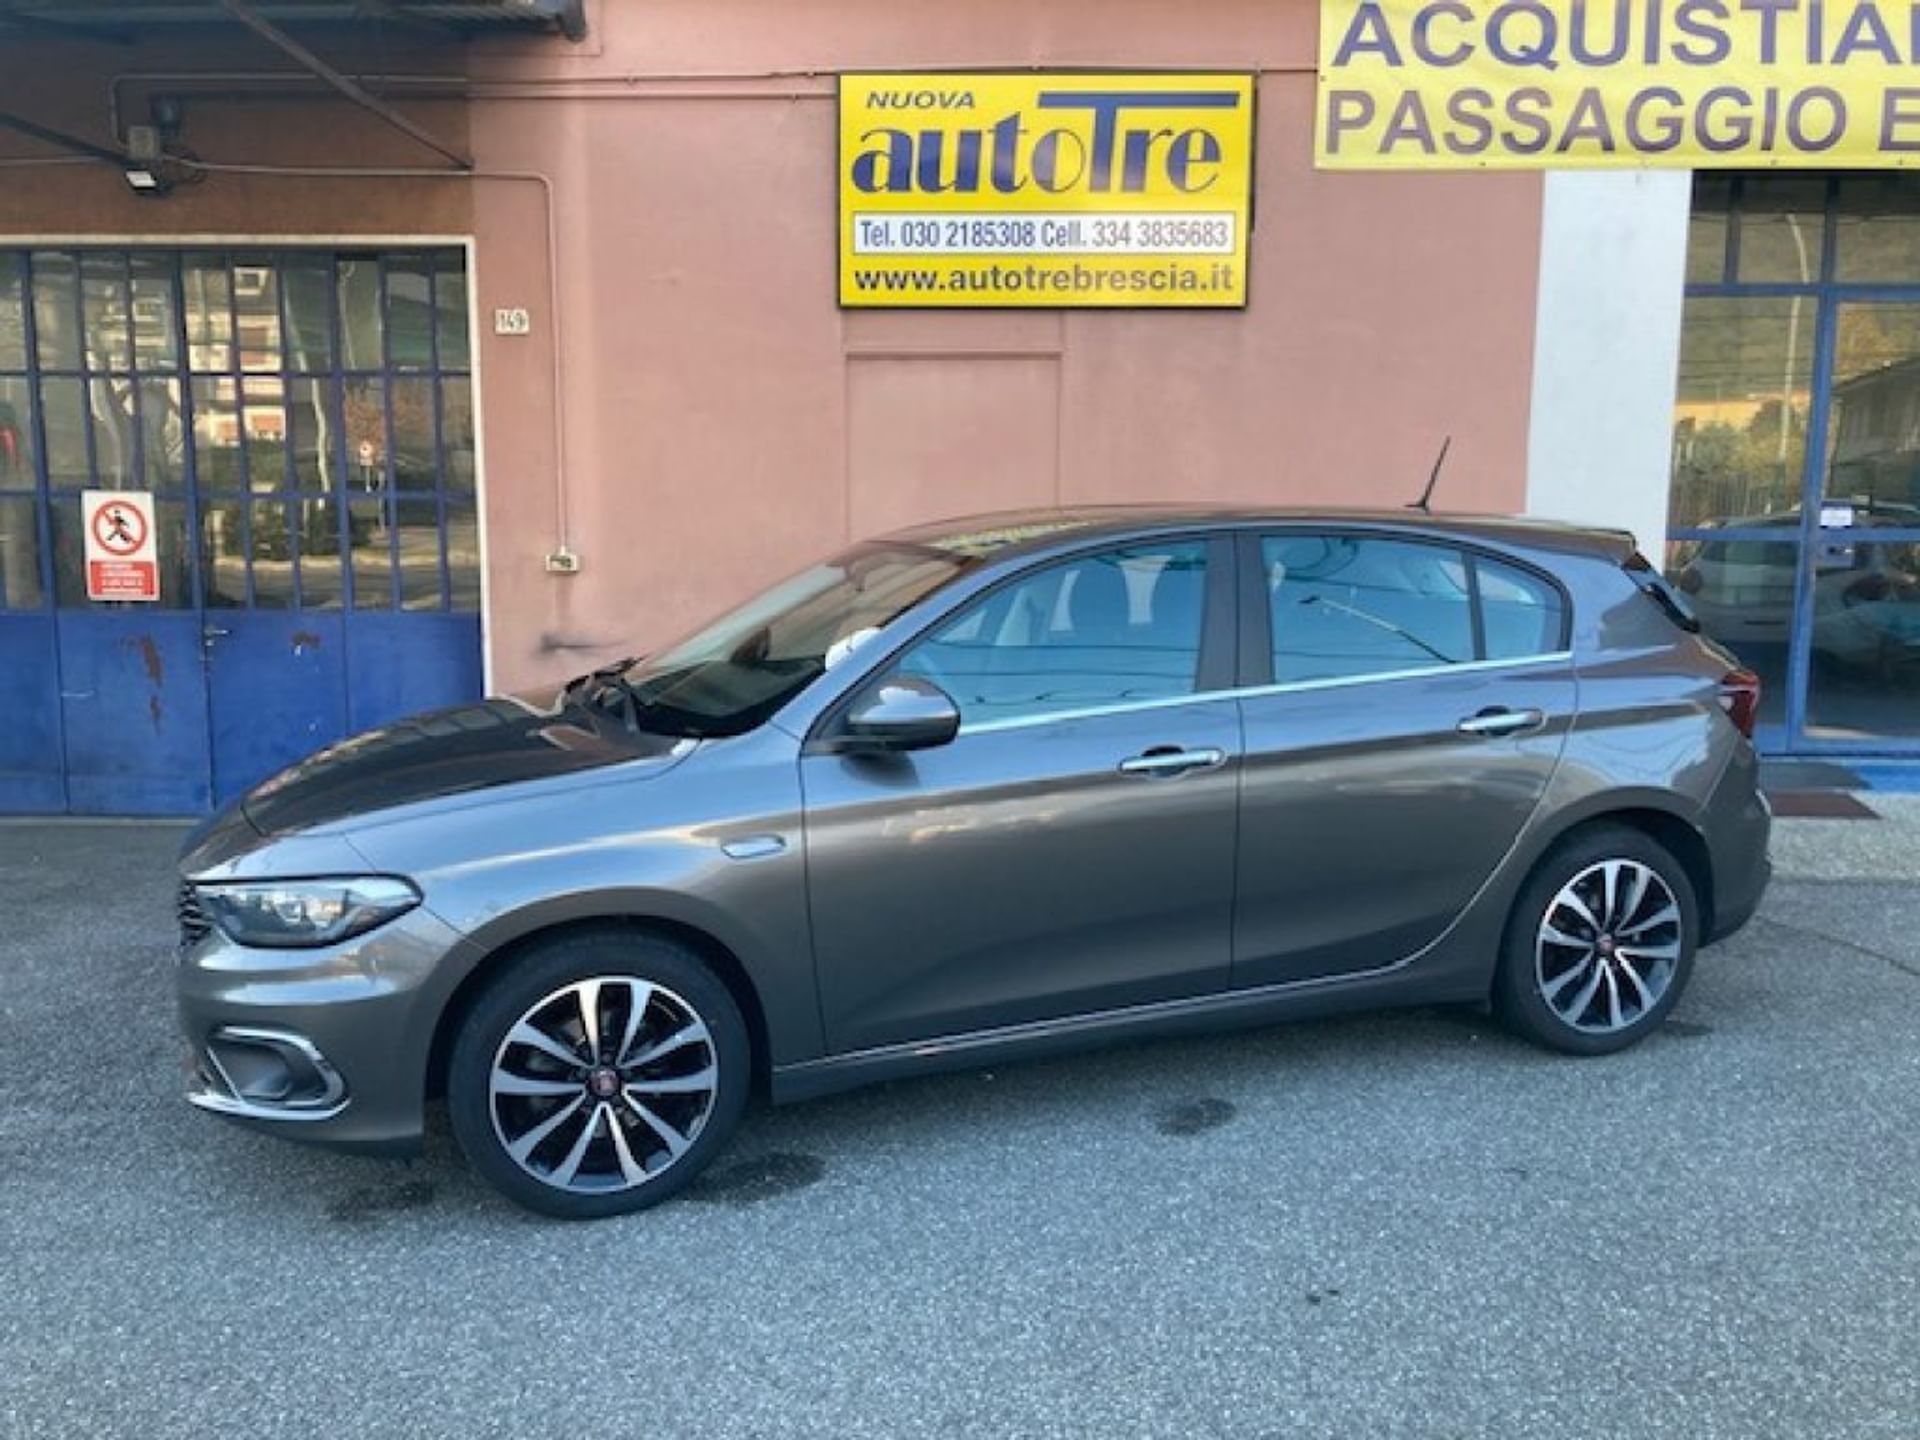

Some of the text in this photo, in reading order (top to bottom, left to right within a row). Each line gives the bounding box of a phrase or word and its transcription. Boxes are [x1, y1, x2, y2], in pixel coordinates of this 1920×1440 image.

[866, 91, 975, 109] NUOVA
[1325, 86, 1847, 155] PASSAGGIO
[860, 219, 1229, 247] Tel. 030 2185308 Cell. 334 3835683
[854, 264, 1234, 292] www.autotrebrescia.it
